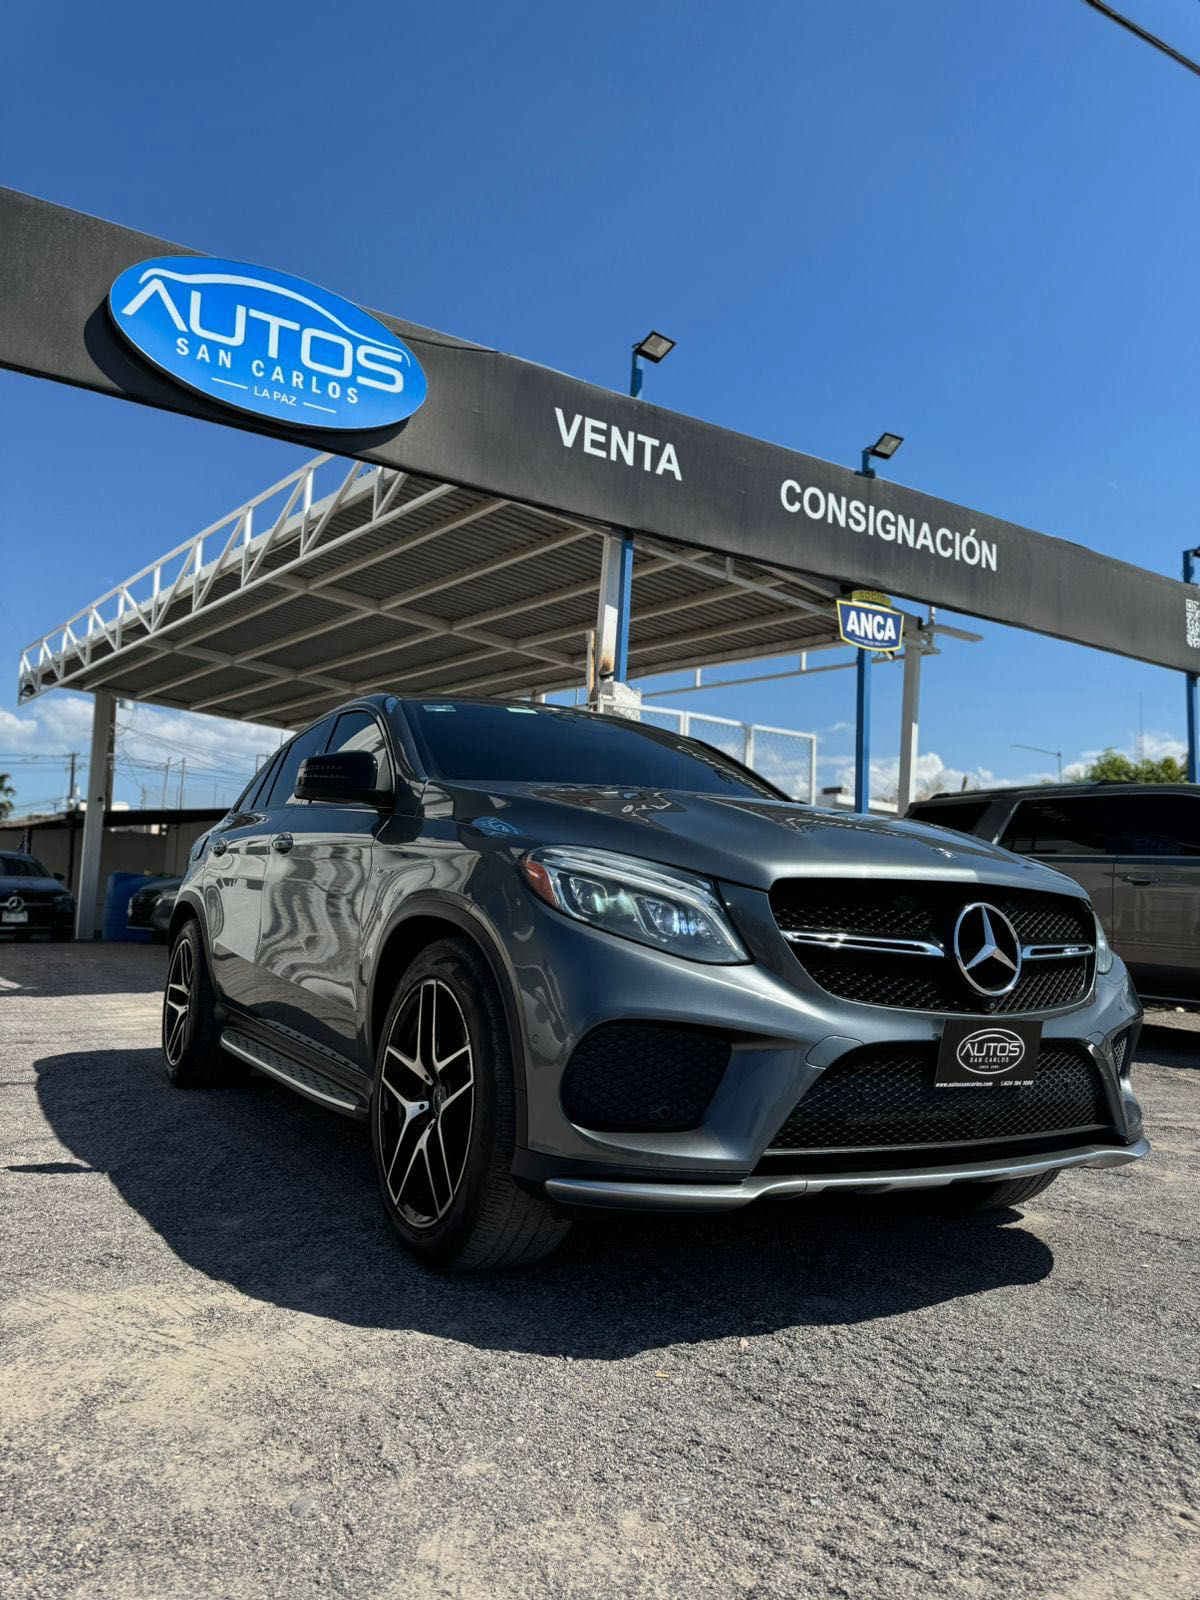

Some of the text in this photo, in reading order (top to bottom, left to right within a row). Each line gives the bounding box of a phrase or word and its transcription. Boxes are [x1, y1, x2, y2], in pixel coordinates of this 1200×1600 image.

[121, 278, 404, 394] AUTOS
[176, 337, 359, 404] SAN CARLOS
[253, 386, 298, 407] LA PAZ
[554, 407, 682, 482] VENTA
[780, 479, 998, 572] CONSIGNACIÓN
[846, 610, 897, 641] ANCA
[960, 1042, 1020, 1057] AUTOS
